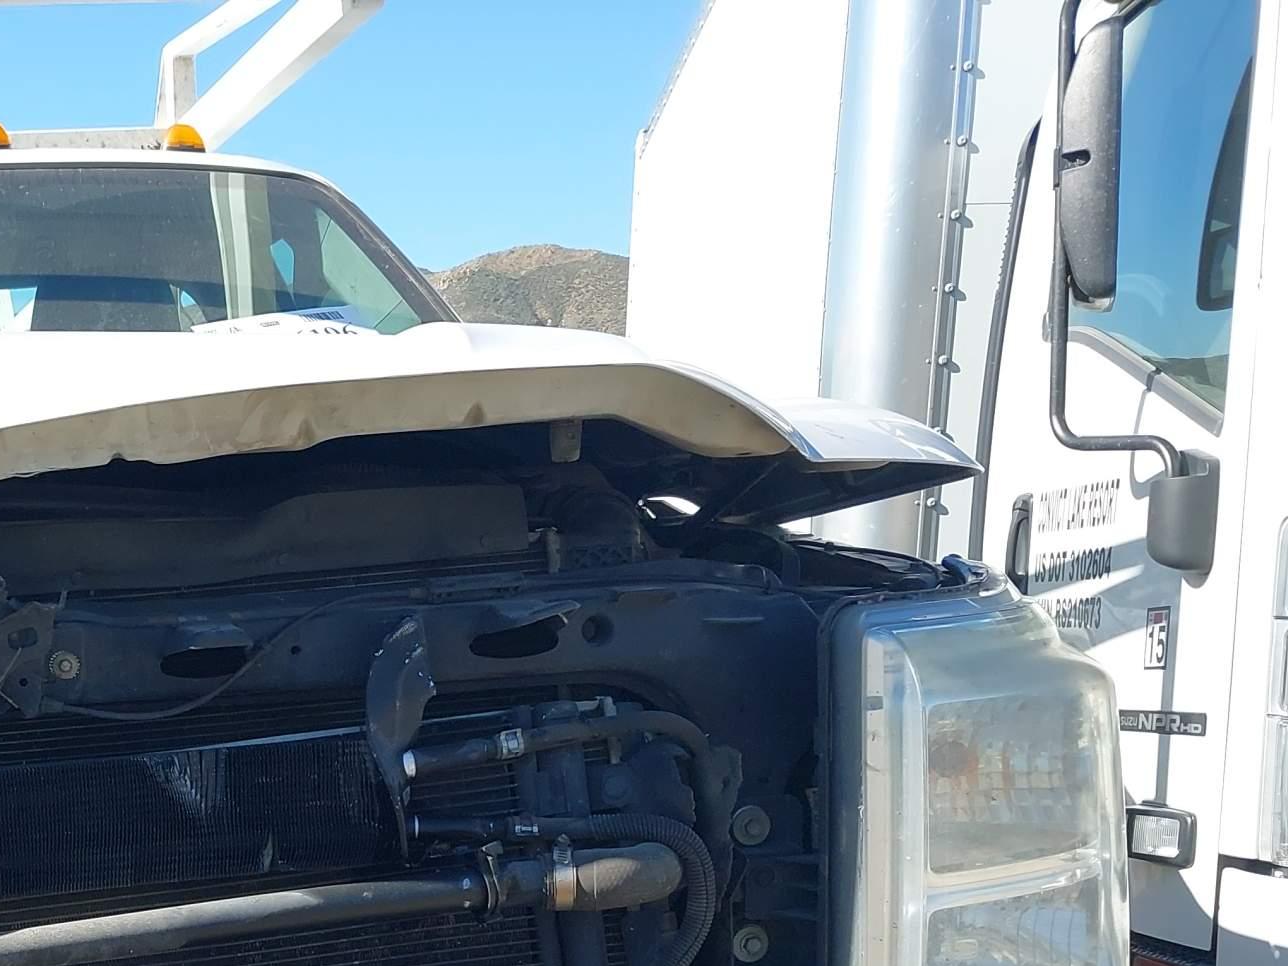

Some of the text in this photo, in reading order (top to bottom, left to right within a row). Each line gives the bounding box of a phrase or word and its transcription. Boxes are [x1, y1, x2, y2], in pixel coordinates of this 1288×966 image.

[1067, 485, 1087, 529] LAKE
[1087, 478, 1120, 527] RESORT
[1035, 546, 1113, 582] US DOT 3102604
[1149, 625, 1166, 665] 15
[1120, 716, 1138, 726] SUZU
